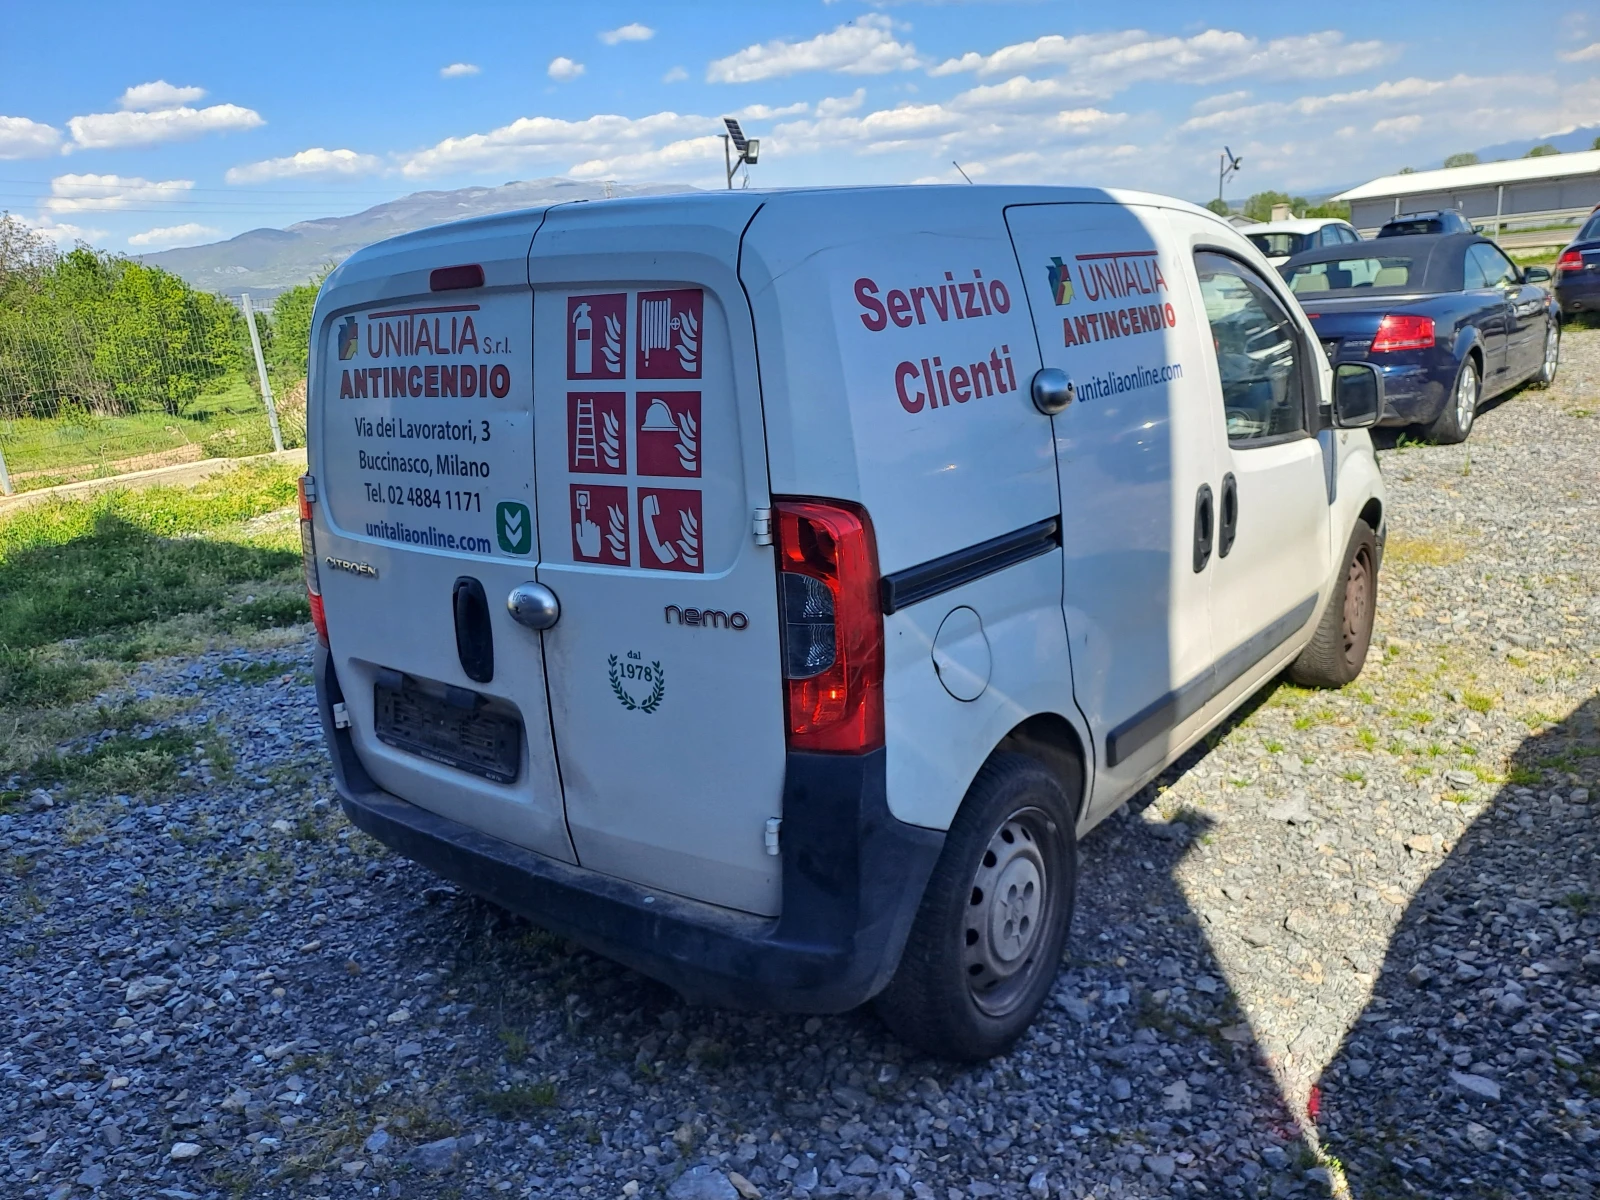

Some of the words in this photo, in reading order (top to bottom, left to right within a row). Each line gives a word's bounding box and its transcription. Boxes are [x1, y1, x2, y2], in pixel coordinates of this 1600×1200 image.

[1076, 250, 1169, 303] UNITALIA
[853, 268, 1011, 332] Servizio
[367, 304, 481, 358] UNITALIA
[483, 336, 512, 354] S.r.l.
[1063, 302, 1177, 348] ANTINCENDIO
[339, 363, 511, 400] ANTINCENDIO
[894, 344, 1018, 414] Clienti
[1076, 362, 1183, 403] unitaliaonline.com
[354, 417, 373, 438] Via
[376, 419, 396, 439] dei
[399, 417, 478, 445] Lavoratori,
[481, 420, 491, 442] 3
[358, 449, 434, 478] Buccinasco,
[436, 453, 491, 478] Milano
[364, 482, 386, 504] Tel.
[387, 485, 404, 506] 02
[406, 487, 442, 509] 4884
[445, 490, 482, 513] 1171
[365, 519, 492, 554] unitaliaonline.com
[664, 604, 749, 631] nemo
[619, 662, 653, 682] 1978
[627, 650, 641, 660] dal
